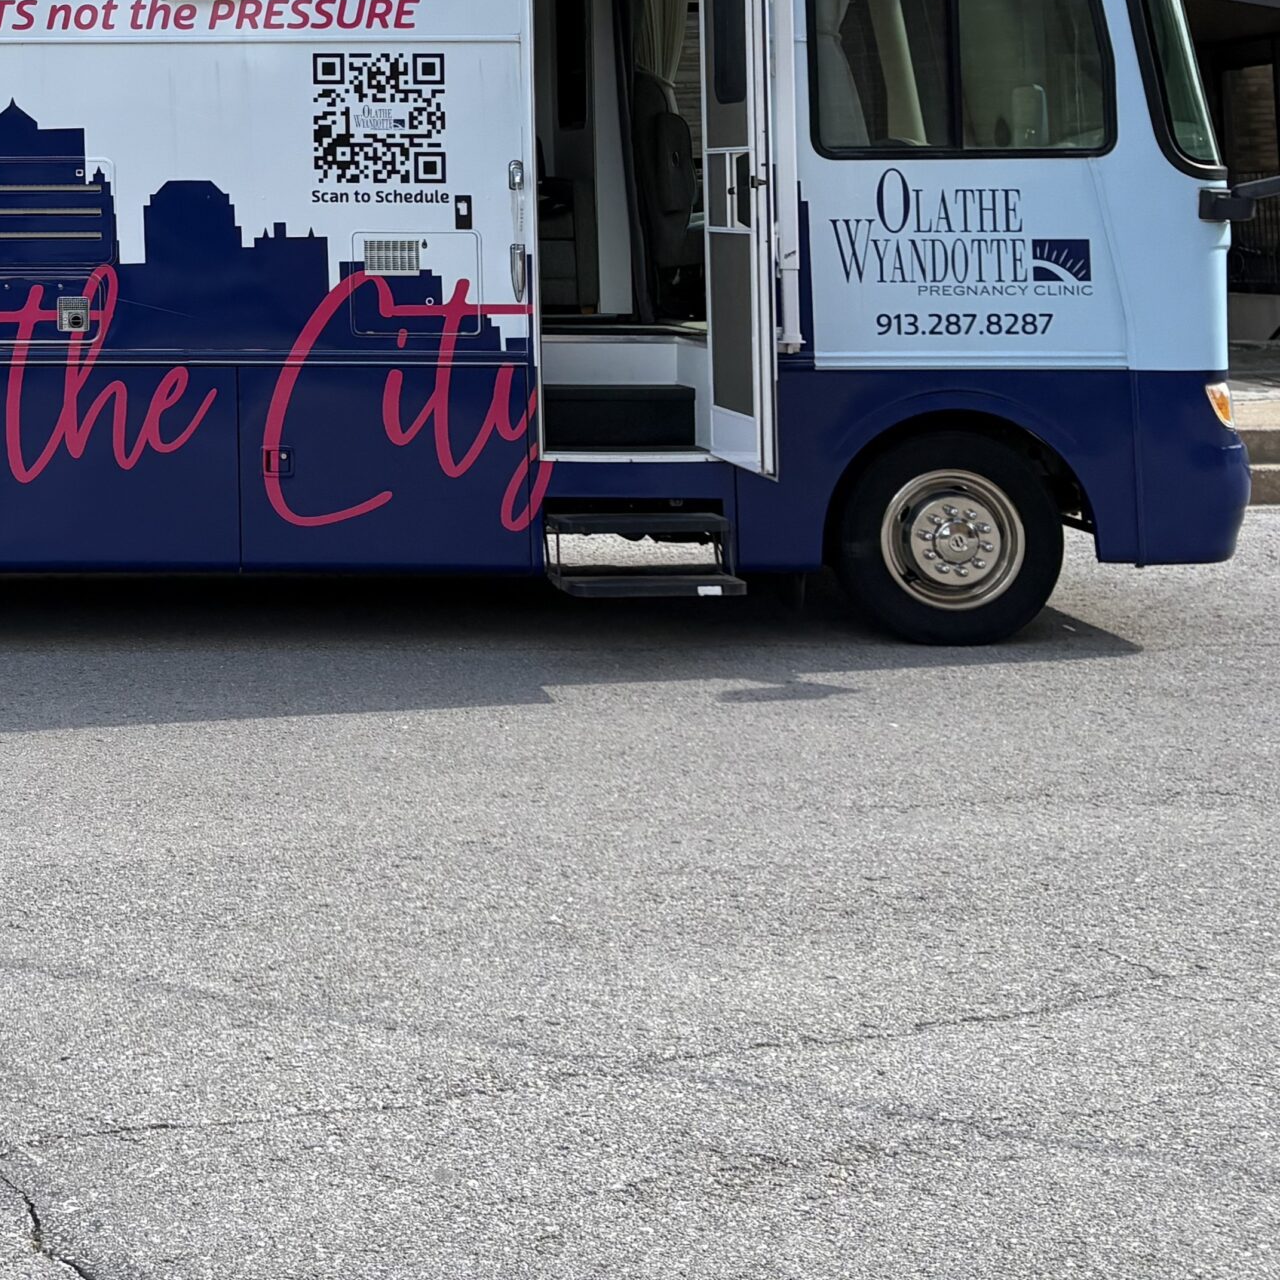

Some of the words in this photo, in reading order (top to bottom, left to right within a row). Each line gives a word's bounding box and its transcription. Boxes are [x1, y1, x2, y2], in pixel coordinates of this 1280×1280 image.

[46, 0, 119, 31] not
[311, 189, 350, 204] Scan
[354, 190, 371, 204] to
[375, 189, 450, 204] Schedule
[875, 167, 1024, 234] OLATHE
[828, 218, 1029, 285] WYANDOTTE
[917, 284, 1029, 297] PREGNANCY
[1033, 284, 1095, 297] CLINIC
[876, 312, 1055, 337] 913.287.8287
[262, 269, 554, 532] City
